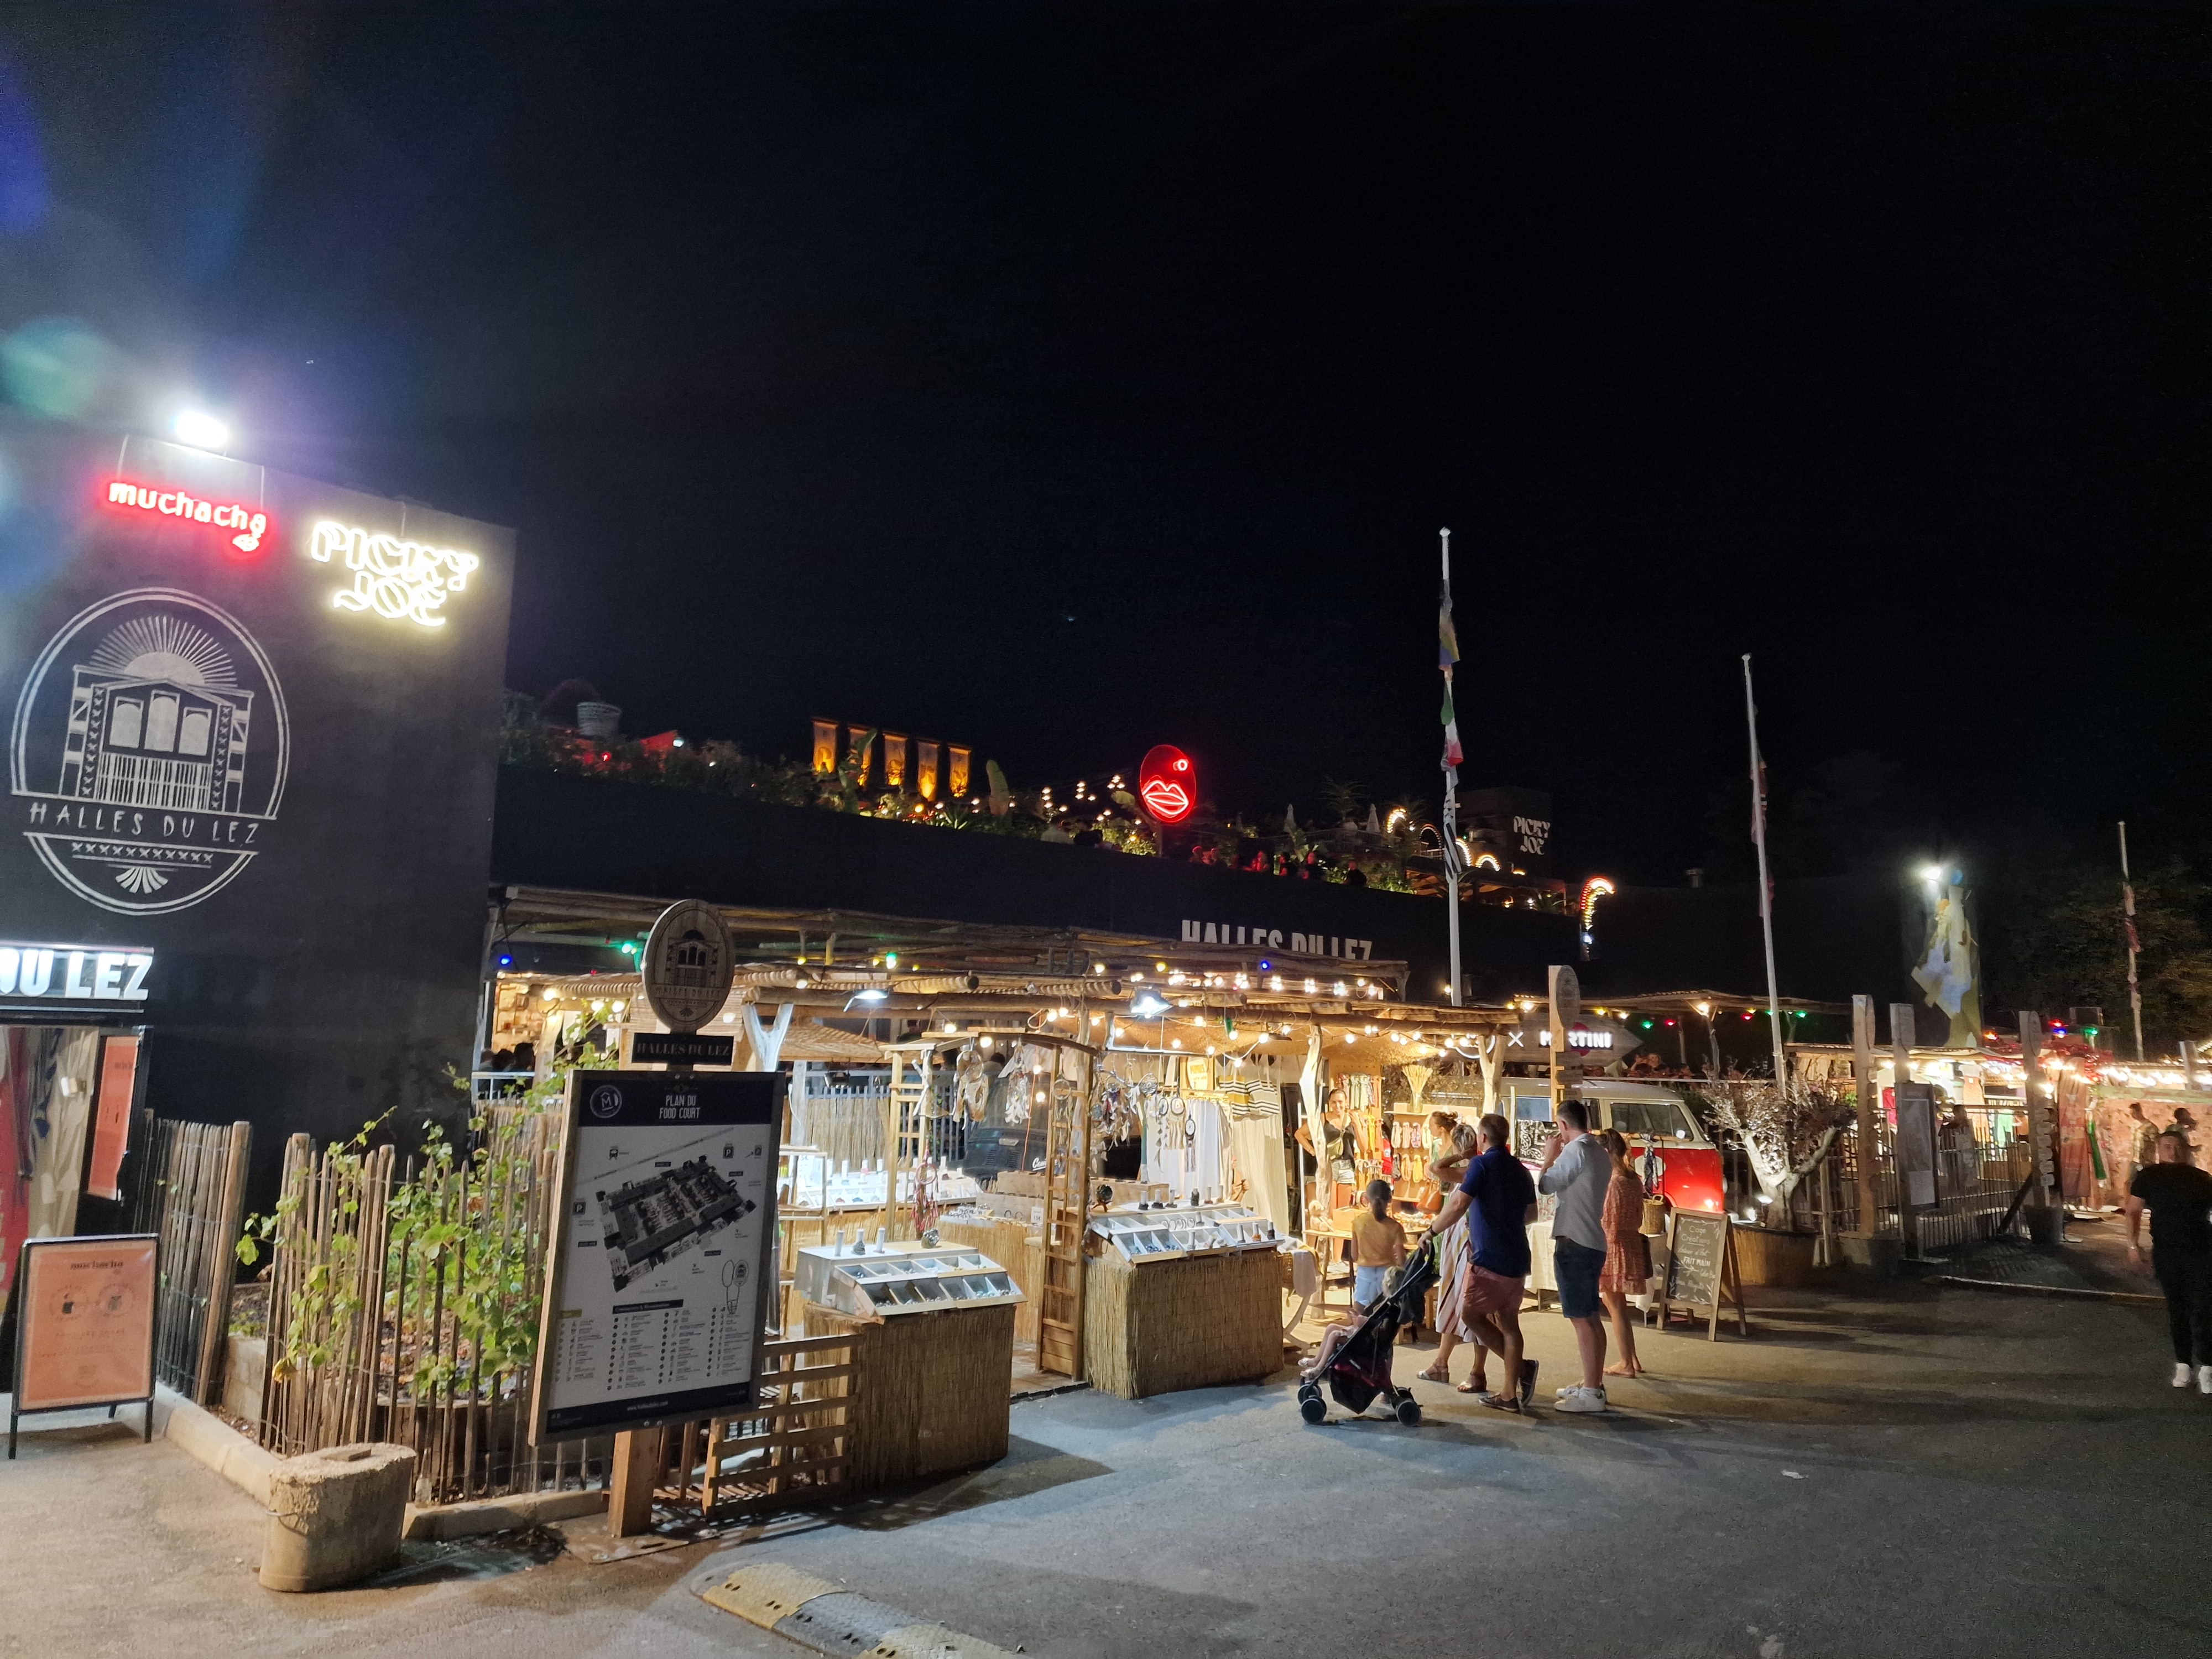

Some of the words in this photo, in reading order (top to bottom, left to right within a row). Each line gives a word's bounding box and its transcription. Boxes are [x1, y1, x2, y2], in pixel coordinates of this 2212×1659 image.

[310, 520, 479, 592] PICKY
[333, 570, 447, 627] JOE
[30, 802, 143, 836] HALLES
[163, 815, 194, 838] DU
[212, 821, 259, 844] LEZ
[1514, 816, 1551, 838] PICKY
[1520, 836, 1545, 855] JOE
[65, 952, 153, 1000] LEZ
[1540, 1030, 1612, 1048] MRTINI
[637, 1042, 686, 1056] HALLES
[688, 1045, 704, 1057] DU
[708, 1045, 731, 1057] LEZ
[665, 1094, 685, 1107] PLAN
[687, 1094, 697, 1105] DU
[659, 1107, 676, 1119] FOOD
[678, 1107, 701, 1119] COURT
[1683, 1256, 1697, 1265] FAIT
[1696, 1258, 1711, 1267] MAIN
